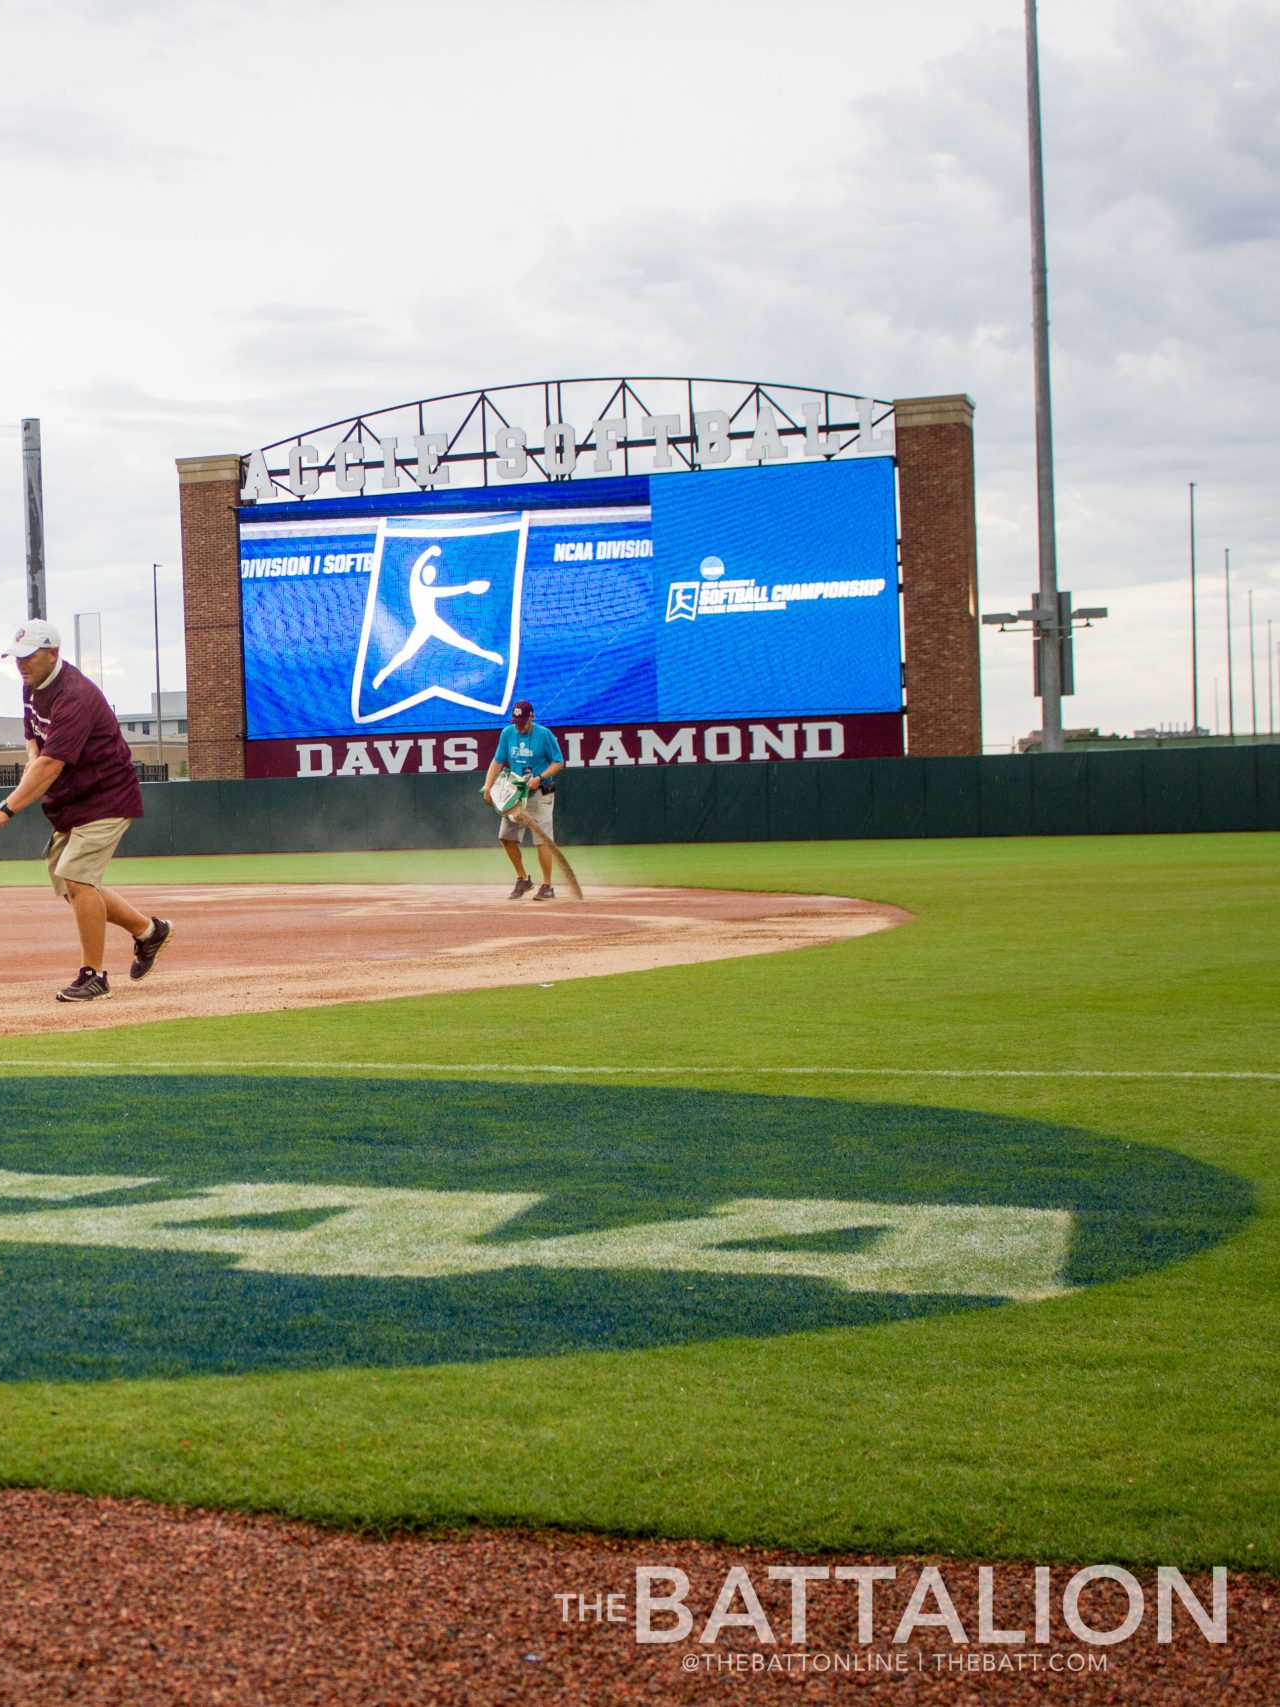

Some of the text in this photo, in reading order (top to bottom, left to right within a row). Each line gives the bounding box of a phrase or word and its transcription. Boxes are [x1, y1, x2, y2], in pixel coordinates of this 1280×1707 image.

[240, 398, 894, 499] AGGIE SOFTBALL
[553, 542, 594, 562] NCAA
[240, 555, 311, 578] DIVISION
[312, 555, 321, 575] I
[698, 585, 769, 606] SOFTBALL
[771, 578, 886, 601] CHAMPIONSHIP
[296, 721, 845, 777] DAVIS IAMOND
